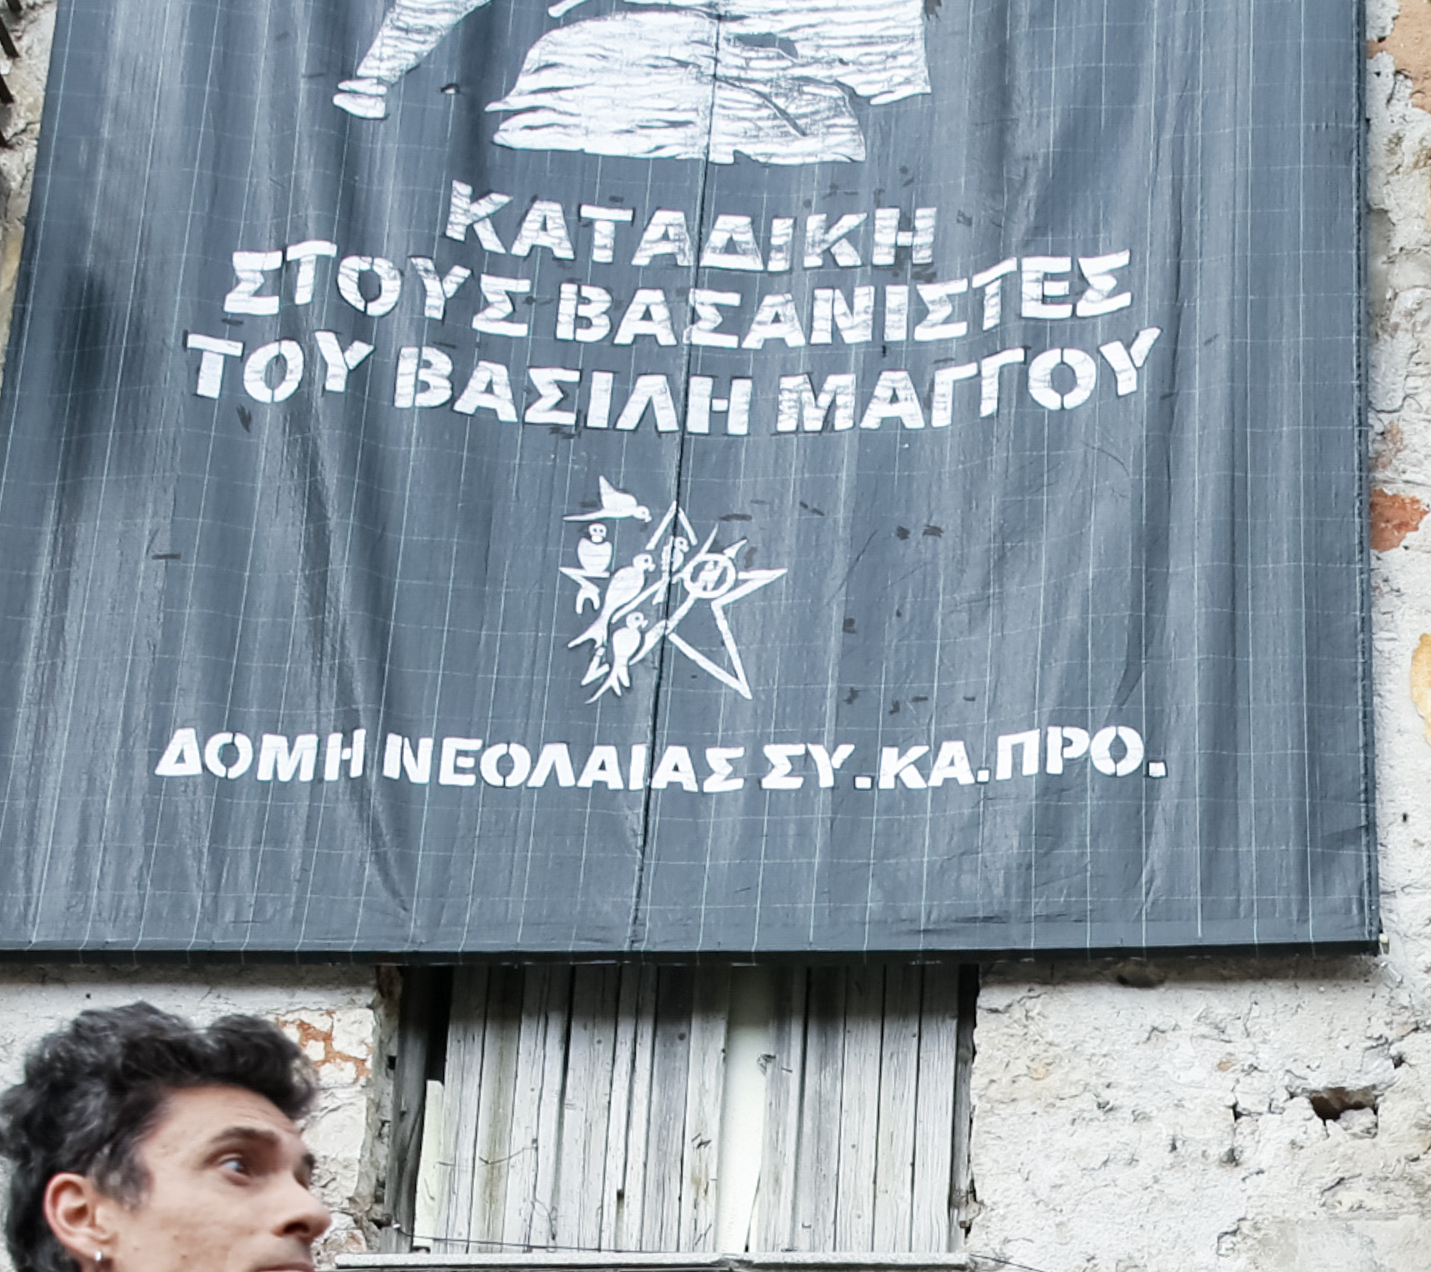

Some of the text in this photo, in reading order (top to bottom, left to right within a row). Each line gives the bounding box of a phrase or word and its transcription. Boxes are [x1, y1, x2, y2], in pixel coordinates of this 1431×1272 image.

[445, 180, 938, 272] ΚΑΤΑΔΙΚΗ
[224, 240, 1133, 349] ΣΤΟΥΣ ΒΑΣΑΝΙΣΤΕΣ
[185, 326, 1164, 435] ΤΟΥ ΒΑΣΙΛΗ ΜΑΓΓΟΥ
[155, 725, 1167, 793] ΔΟΜΗ ΝΕΟΛΑΙΑΣ ΣΥ.ΚΑ.ΠΡΟ.
